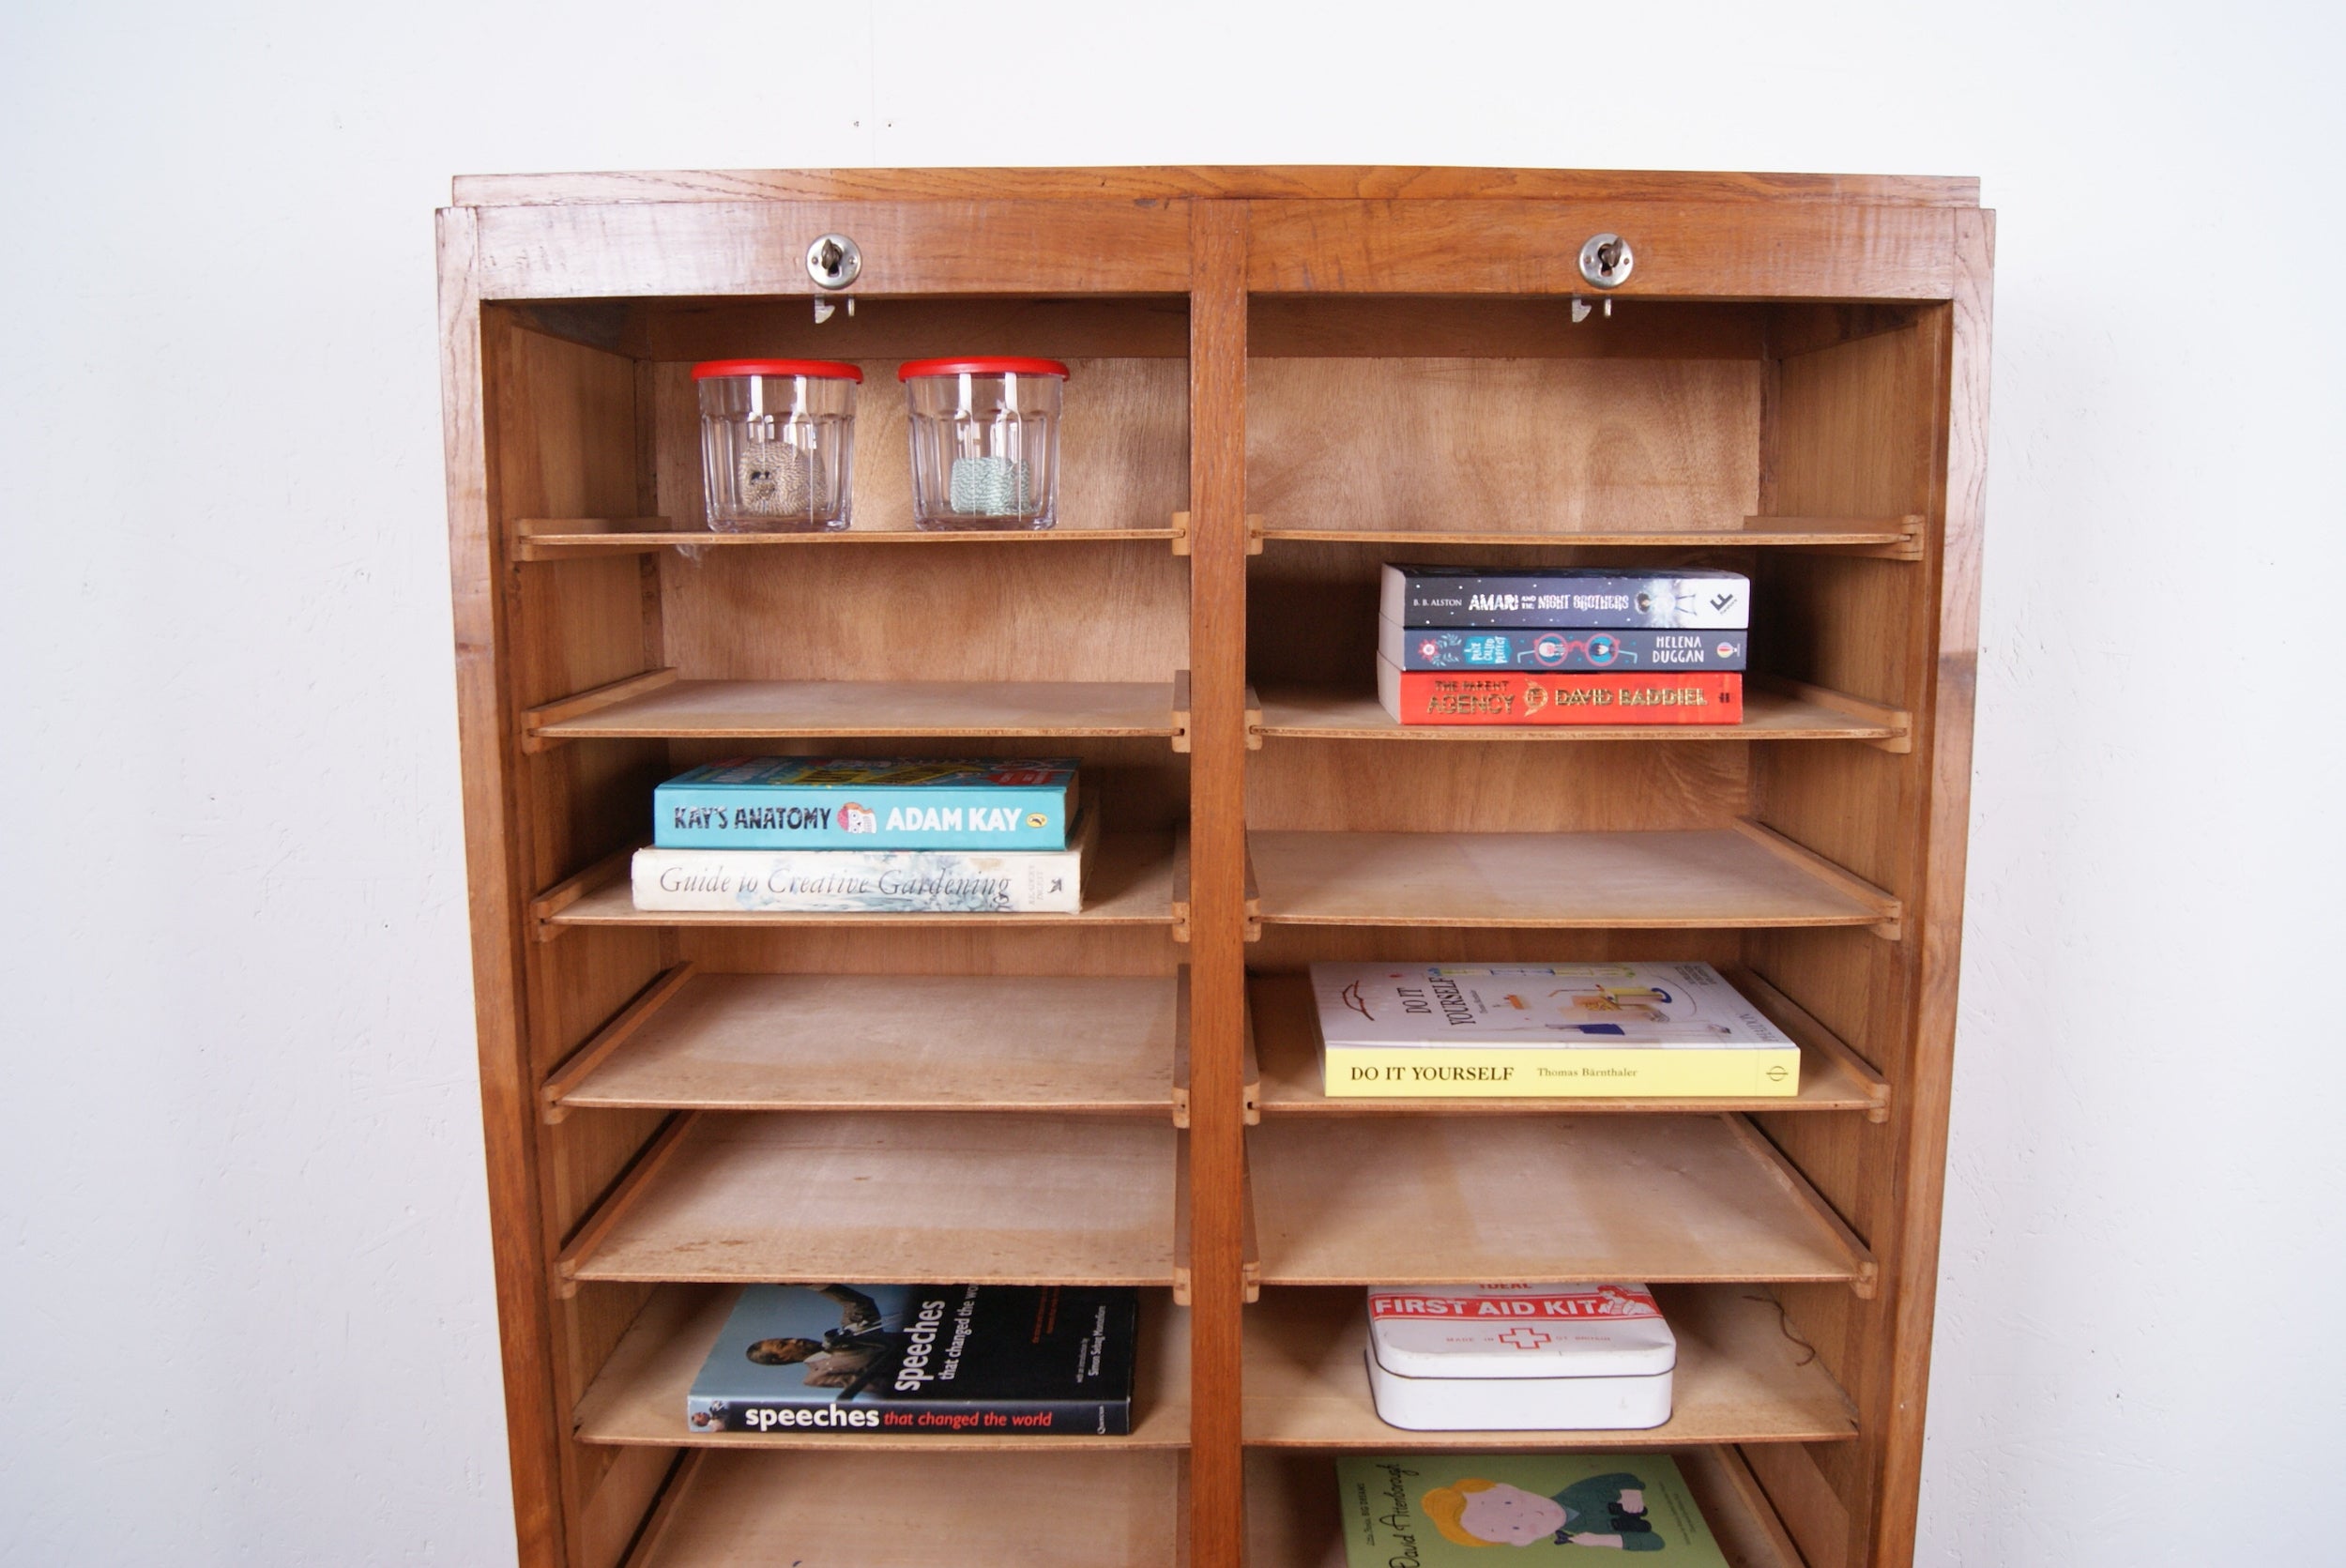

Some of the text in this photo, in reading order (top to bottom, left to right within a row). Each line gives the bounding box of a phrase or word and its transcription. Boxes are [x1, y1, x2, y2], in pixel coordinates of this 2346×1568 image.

[1431, 599, 1462, 607] ALSTON
[1468, 594, 1518, 611] AMARI
[1537, 594, 1572, 610] NIGHT
[1573, 594, 1629, 611] BROTHERS
[1655, 635, 1702, 648] HELENA
[1652, 650, 1704, 663] DUGGAN
[1435, 680, 1510, 692] THE PARENT
[1426, 693, 1516, 714] AGENCY
[1555, 689, 1614, 707] DAVID
[1619, 688, 1708, 707] BADDIEL
[674, 806, 831, 830] KAY'S ANATOMY
[885, 807, 1022, 831] ADAM KAY
[659, 865, 731, 893] Guide
[739, 871, 759, 893] to
[768, 867, 870, 894] Creative
[878, 867, 1013, 905] Gardening
[1396, 987, 1432, 1013] DO IT
[1428, 977, 1476, 1026] YOURSELF
[1351, 1066, 1515, 1080] DO IT YOURSELF
[1537, 1067, 1638, 1077] Thomas Bärnthaler
[957, 1301, 975, 1317] the
[1374, 1299, 1597, 1316] FIRST AID KIT
[894, 1301, 946, 1391] speeches
[945, 1318, 972, 1358] changed
[938, 1359, 959, 1380] that
[745, 1403, 1053, 1431] speeches that changed the world
[1389, 1534, 1421, 1568] David
